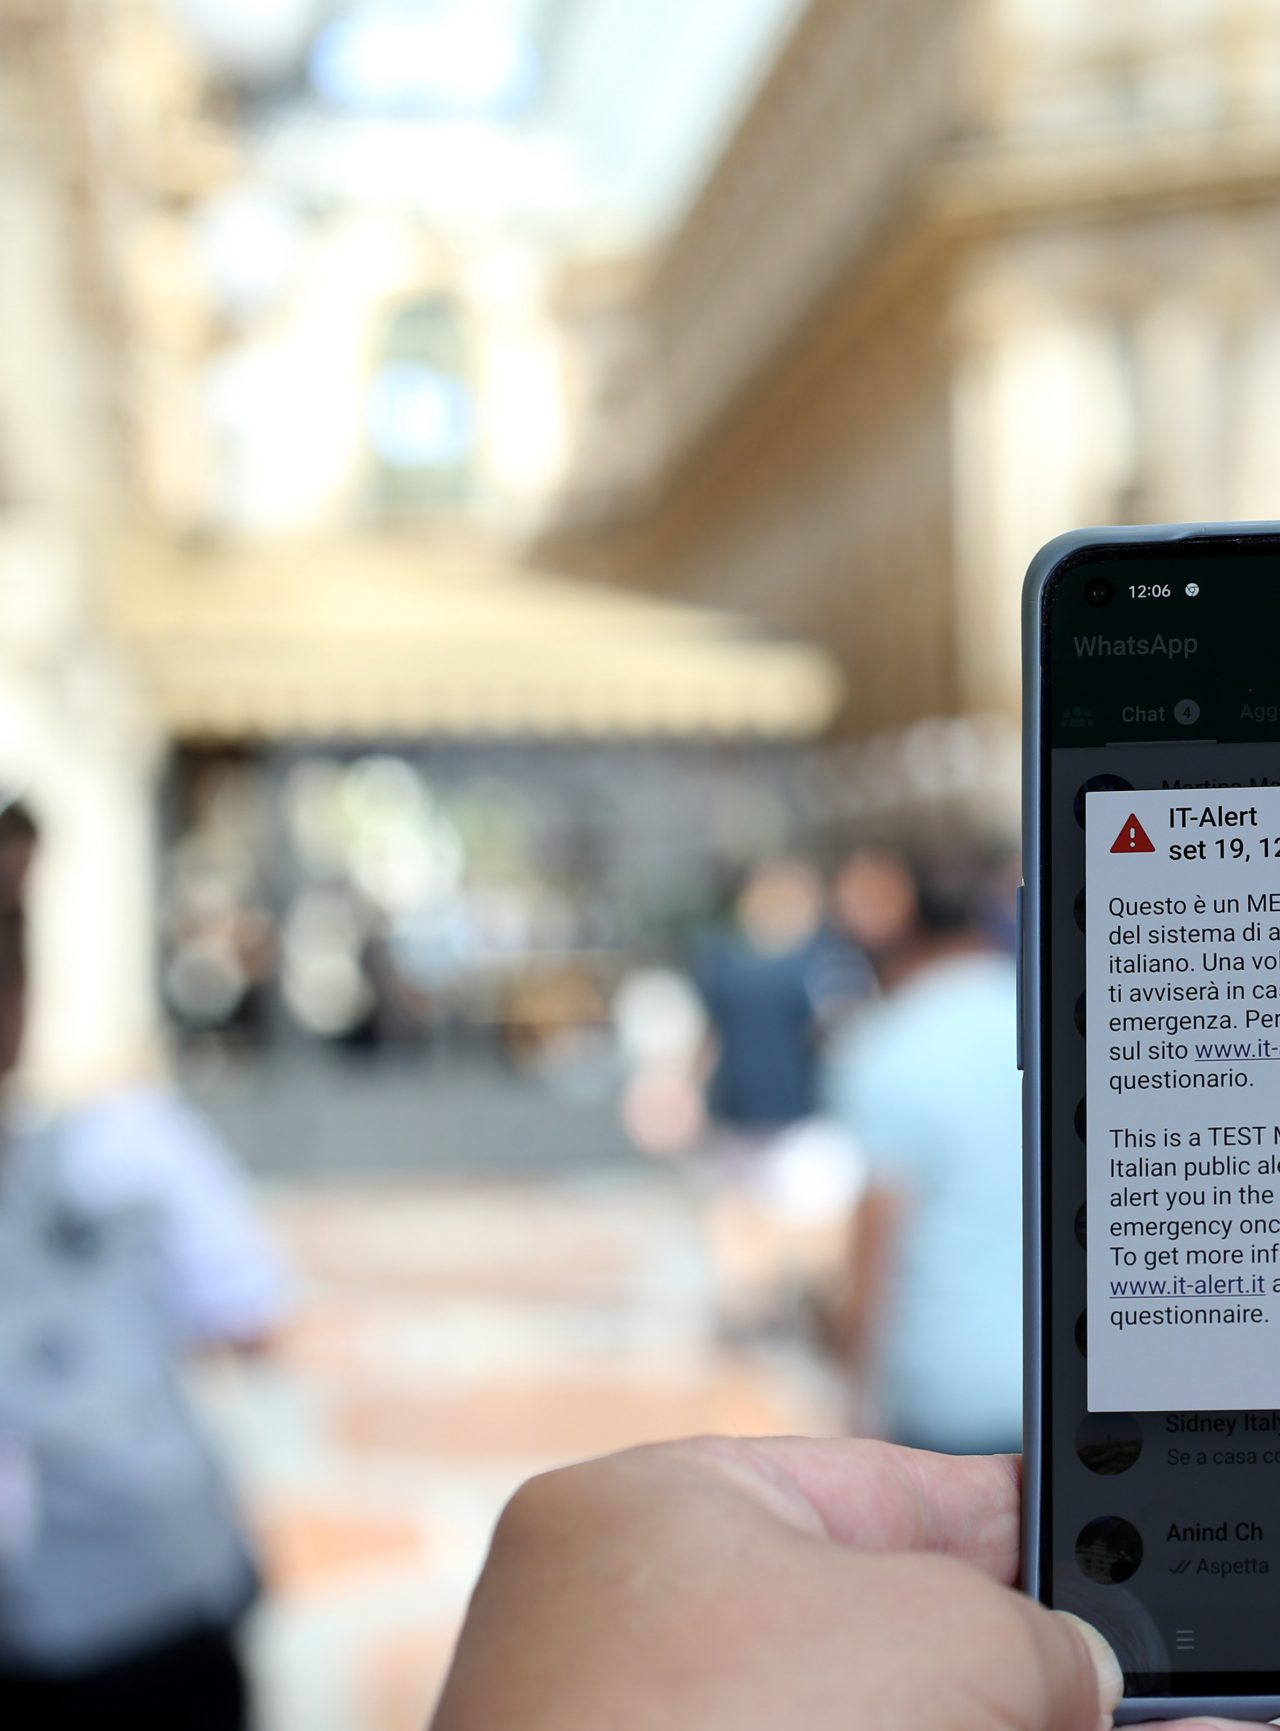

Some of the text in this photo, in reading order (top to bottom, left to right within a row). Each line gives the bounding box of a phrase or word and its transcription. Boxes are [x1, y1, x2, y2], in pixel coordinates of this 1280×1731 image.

[1129, 585, 1170, 598] 12:06
[1074, 634, 1197, 659] WhatsApp
[1122, 706, 1191, 722] Chat 4
[1170, 806, 1257, 828] IT-Alert
[1170, 841, 1206, 860] set
[1216, 838, 1250, 862] 19,
[1109, 898, 1186, 918] Questo
[1194, 895, 1205, 914] è
[1214, 899, 1238, 913] un
[1109, 925, 1139, 945] del
[1149, 925, 1234, 944] sistema
[1243, 922, 1260, 941] di
[1110, 954, 1194, 973] italiano.
[1203, 953, 1244, 971] Una
[1109, 984, 1121, 1002] ti
[1130, 981, 1218, 1002] avviserà
[1227, 981, 1244, 999] in
[1110, 1015, 1236, 1035] emergenza.
[1110, 1041, 1140, 1060] sul
[1149, 1041, 1187, 1059] sito
[1110, 1069, 1253, 1094] questionario.
[1110, 1129, 1155, 1148] This
[1165, 1129, 1181, 1147] is
[1189, 1133, 1200, 1146] a
[1208, 1127, 1266, 1146] TEST
[1111, 1158, 1176, 1177] Italian
[1185, 1156, 1250, 1181] public
[1111, 1187, 1158, 1207] alert
[1166, 1191, 1204, 1211] you
[1214, 1186, 1231, 1204] in
[1238, 1185, 1273, 1204] the
[1110, 1220, 1232, 1240] emergency
[1110, 1247, 1136, 1265] To
[1145, 1248, 1178, 1270] get
[1187, 1250, 1243, 1264] more
[1110, 1274, 1265, 1298] www.it-alert.it
[1111, 1304, 1268, 1330] questionnaire.
[1166, 1414, 1236, 1436] Sidney
[1168, 1449, 1190, 1465] Se
[1197, 1452, 1206, 1465] a
[1213, 1452, 1256, 1464] casa
[1167, 1522, 1262, 1542] Anind Ch
[1197, 1558, 1269, 1578] Aspetta
